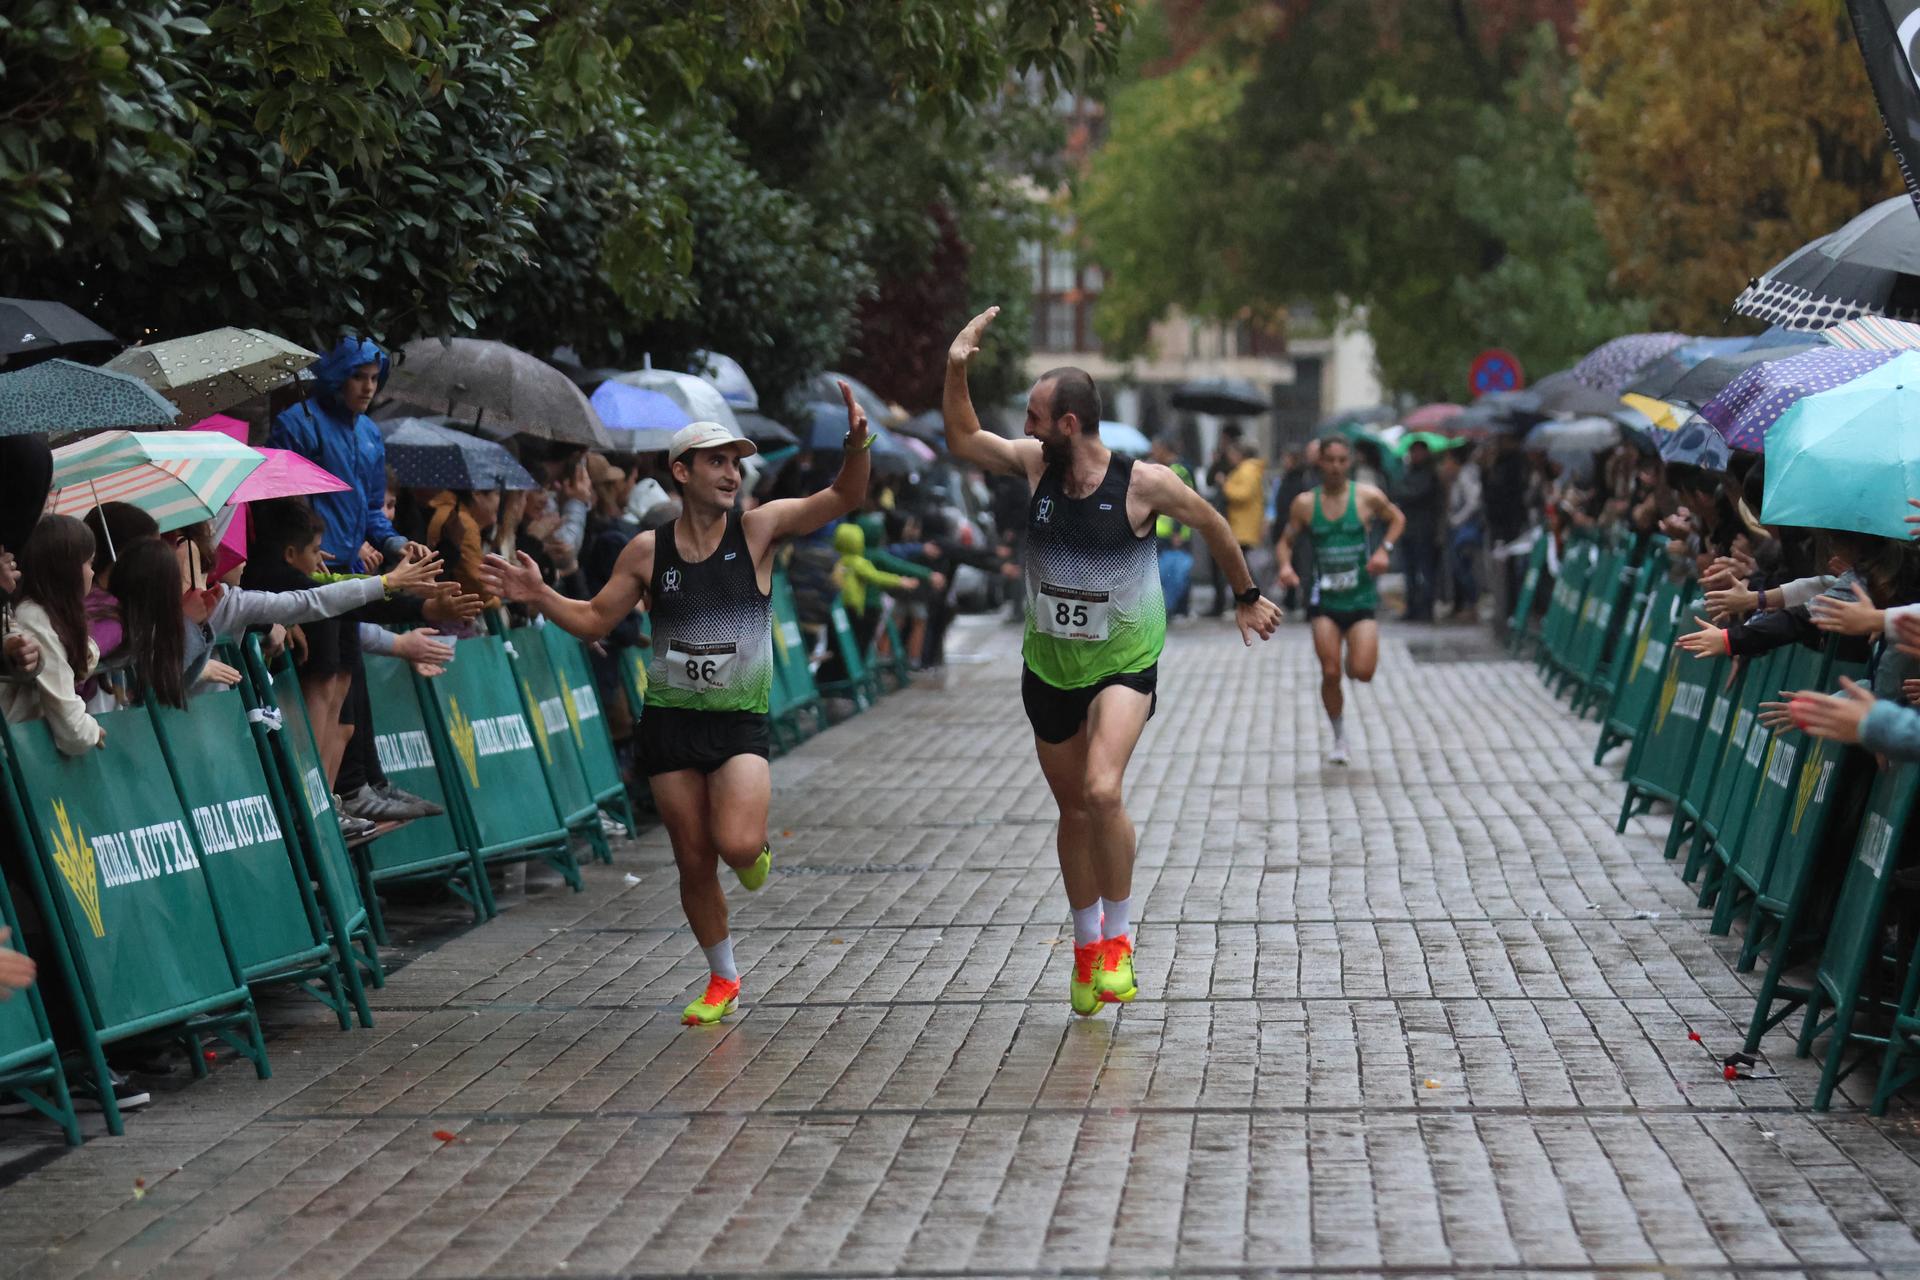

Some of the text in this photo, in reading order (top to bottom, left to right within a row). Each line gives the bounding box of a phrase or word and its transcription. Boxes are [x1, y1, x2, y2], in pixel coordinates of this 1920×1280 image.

[1055, 602, 1088, 627] 85
[685, 660, 716, 682] 86
[191, 794, 283, 856] URAL KUTXA
[91, 819, 200, 888] RURAL KUTXA
